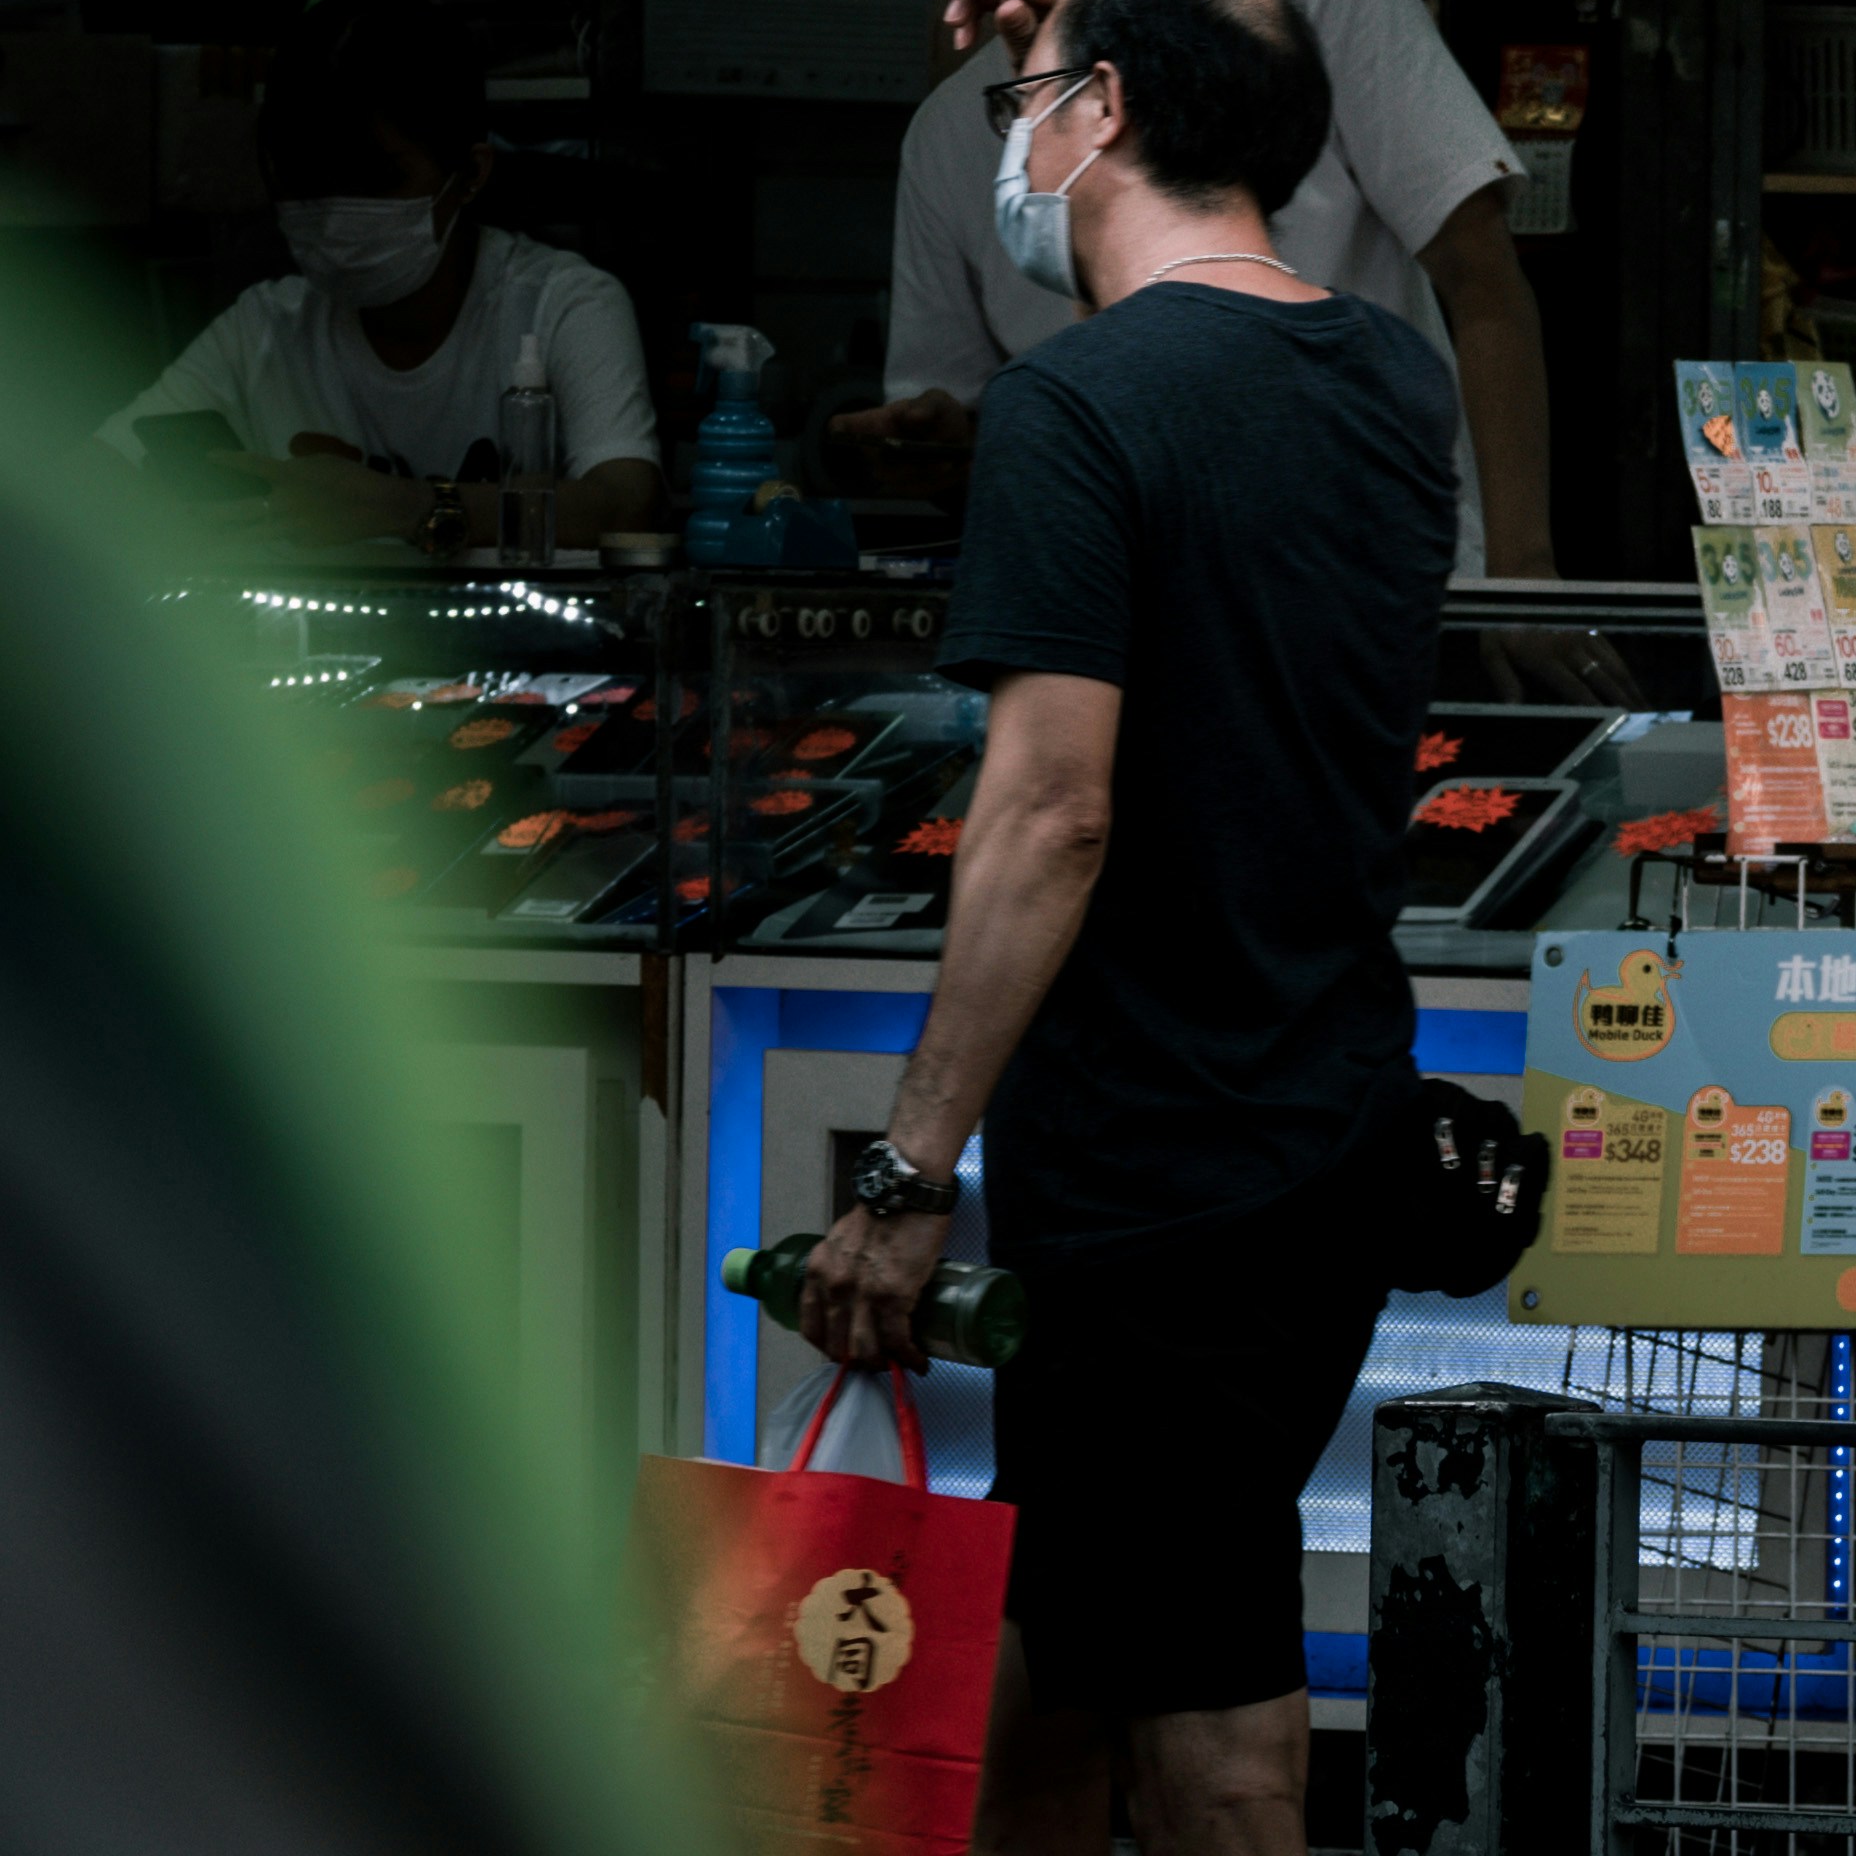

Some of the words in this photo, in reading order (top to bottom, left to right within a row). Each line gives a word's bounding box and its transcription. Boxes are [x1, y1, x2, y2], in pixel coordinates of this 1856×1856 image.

[1767, 714, 1813, 750] $238
[1588, 1028, 1629, 1043] Mobile
[1631, 1028, 1664, 1043] Duck
[1605, 1140, 1662, 1164] $348
[1730, 1139, 1787, 1165] $238
[828, 1572, 888, 1690] 大同
